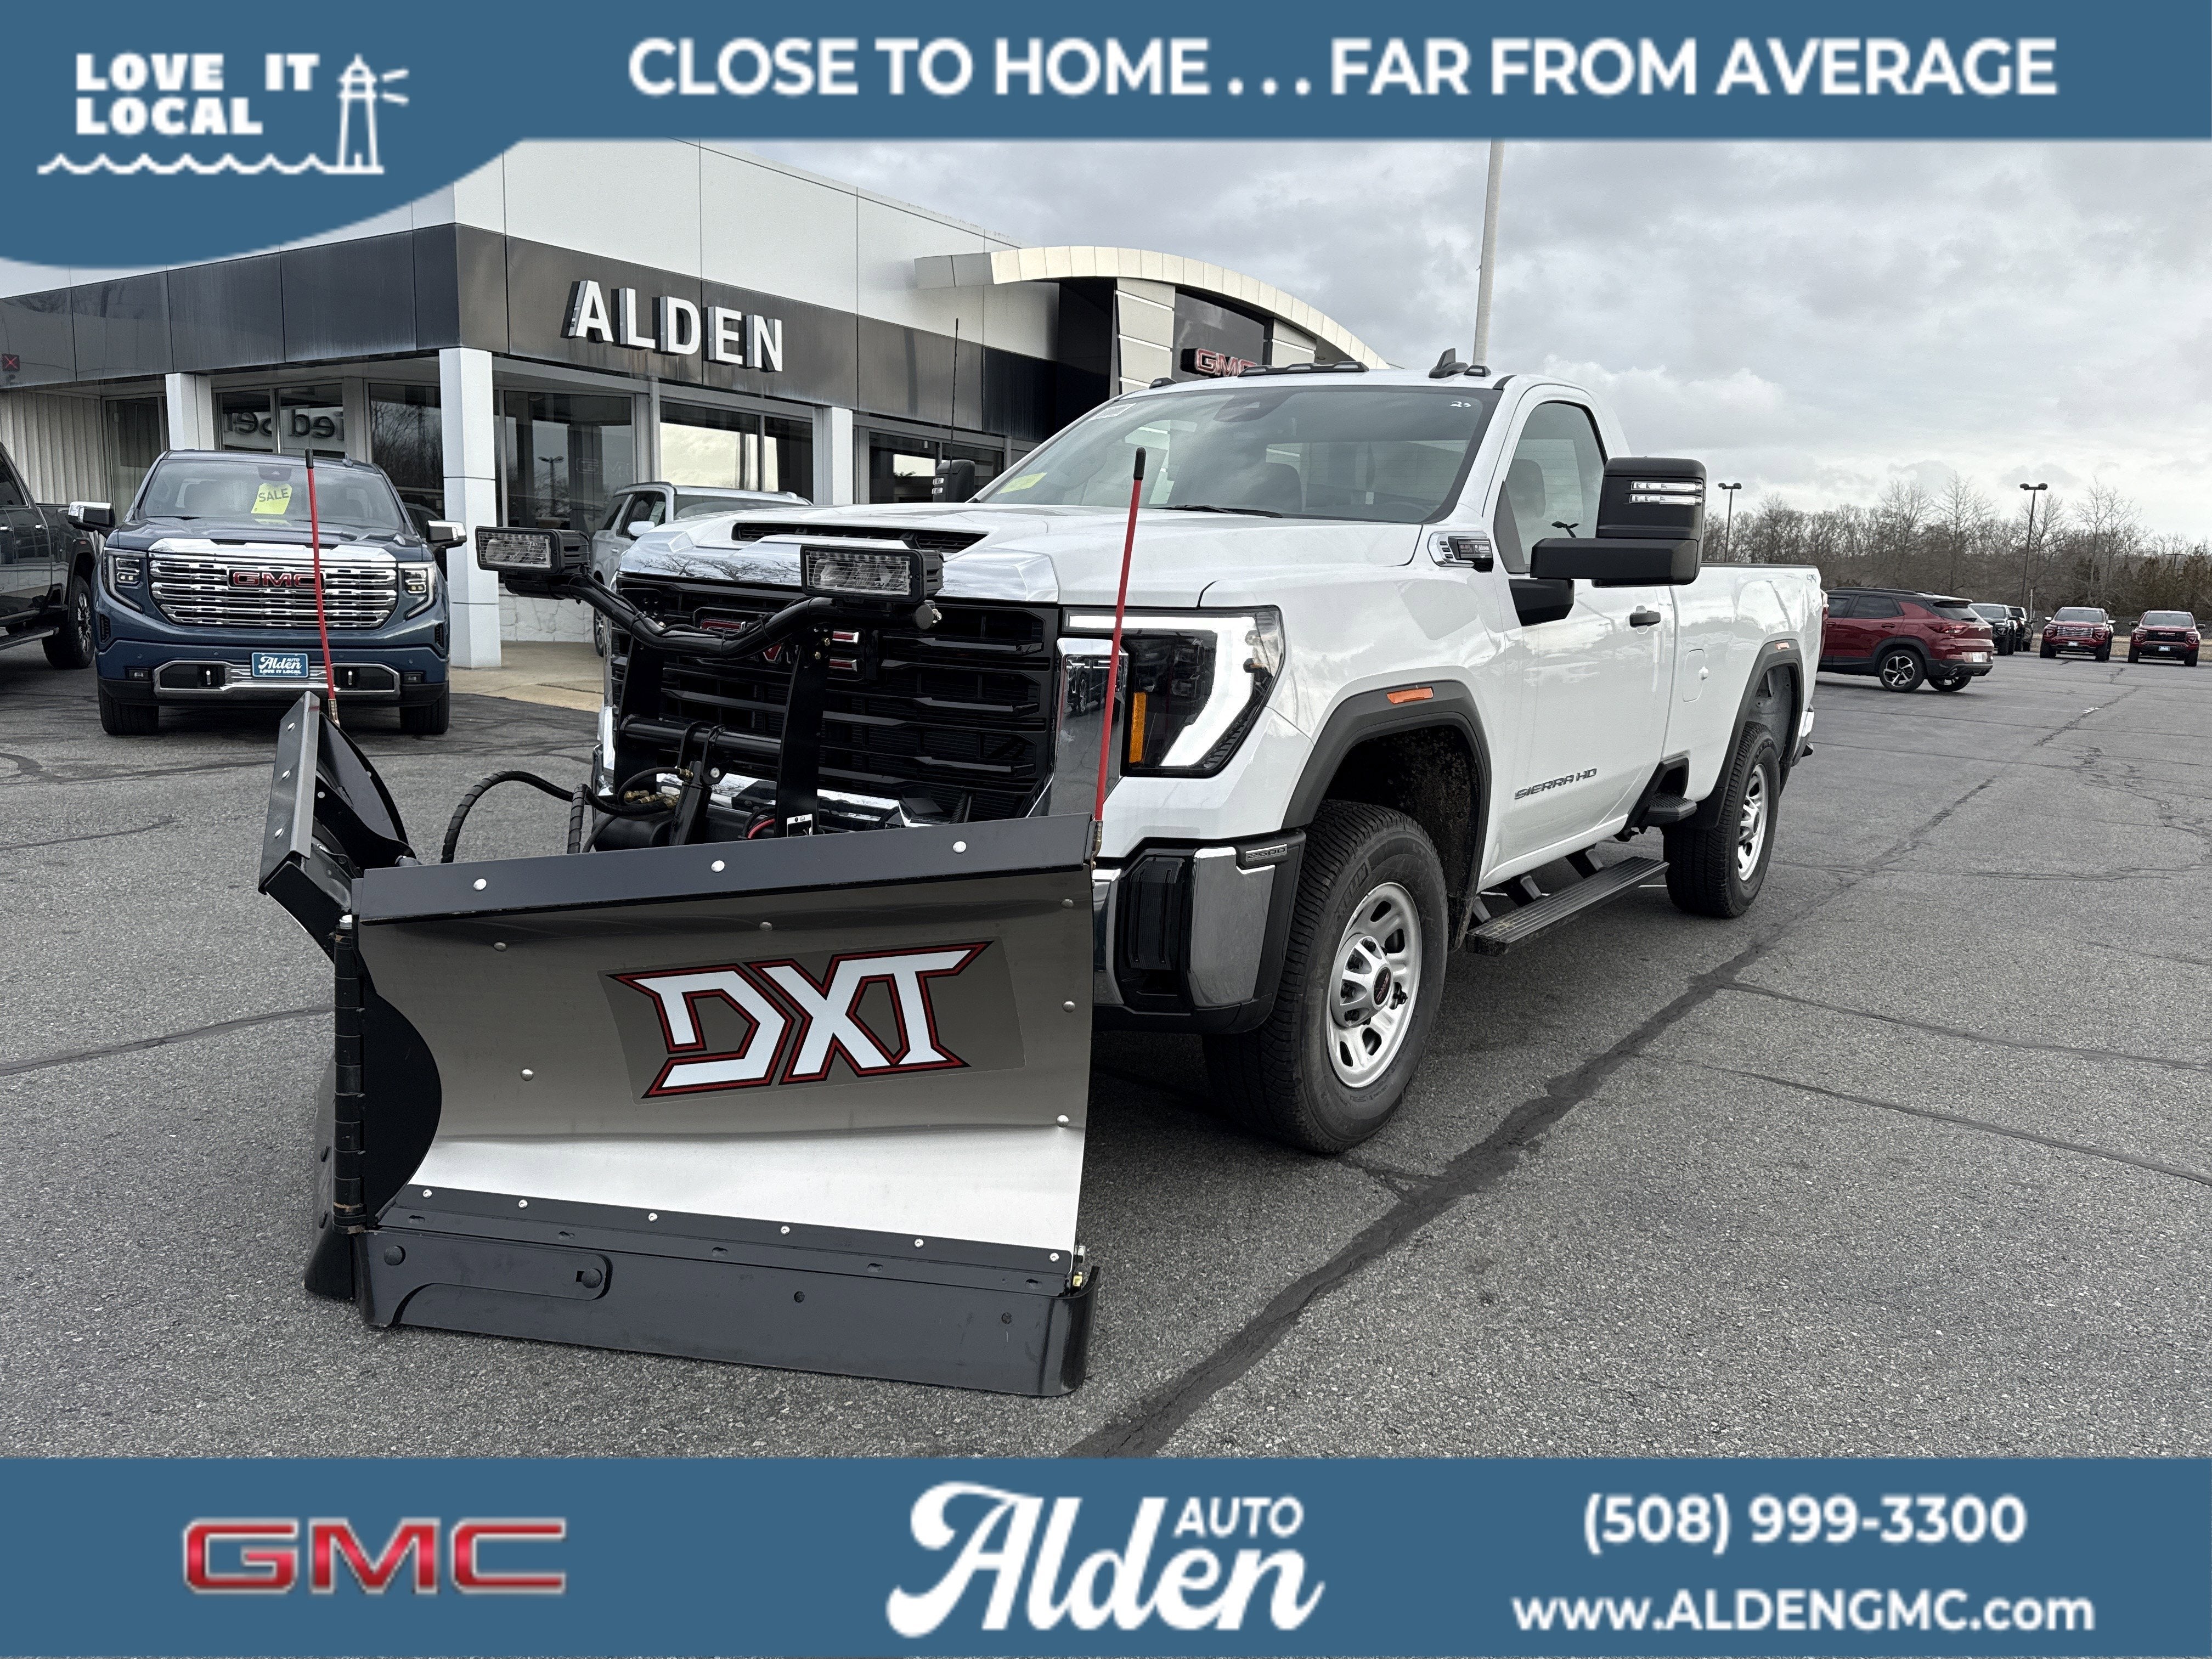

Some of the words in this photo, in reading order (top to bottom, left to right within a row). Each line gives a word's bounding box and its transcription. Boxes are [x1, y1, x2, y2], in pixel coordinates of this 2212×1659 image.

[568, 280, 783, 371] ALDEN
[258, 488, 289, 502] SALE
[233, 571, 317, 588] GMC
[258, 656, 302, 669] Alden
[1514, 774, 1574, 800] SIERRA
[1576, 768, 1597, 782] HD
[1248, 848, 1285, 859] 2500
[608, 940, 994, 1099] DXT
